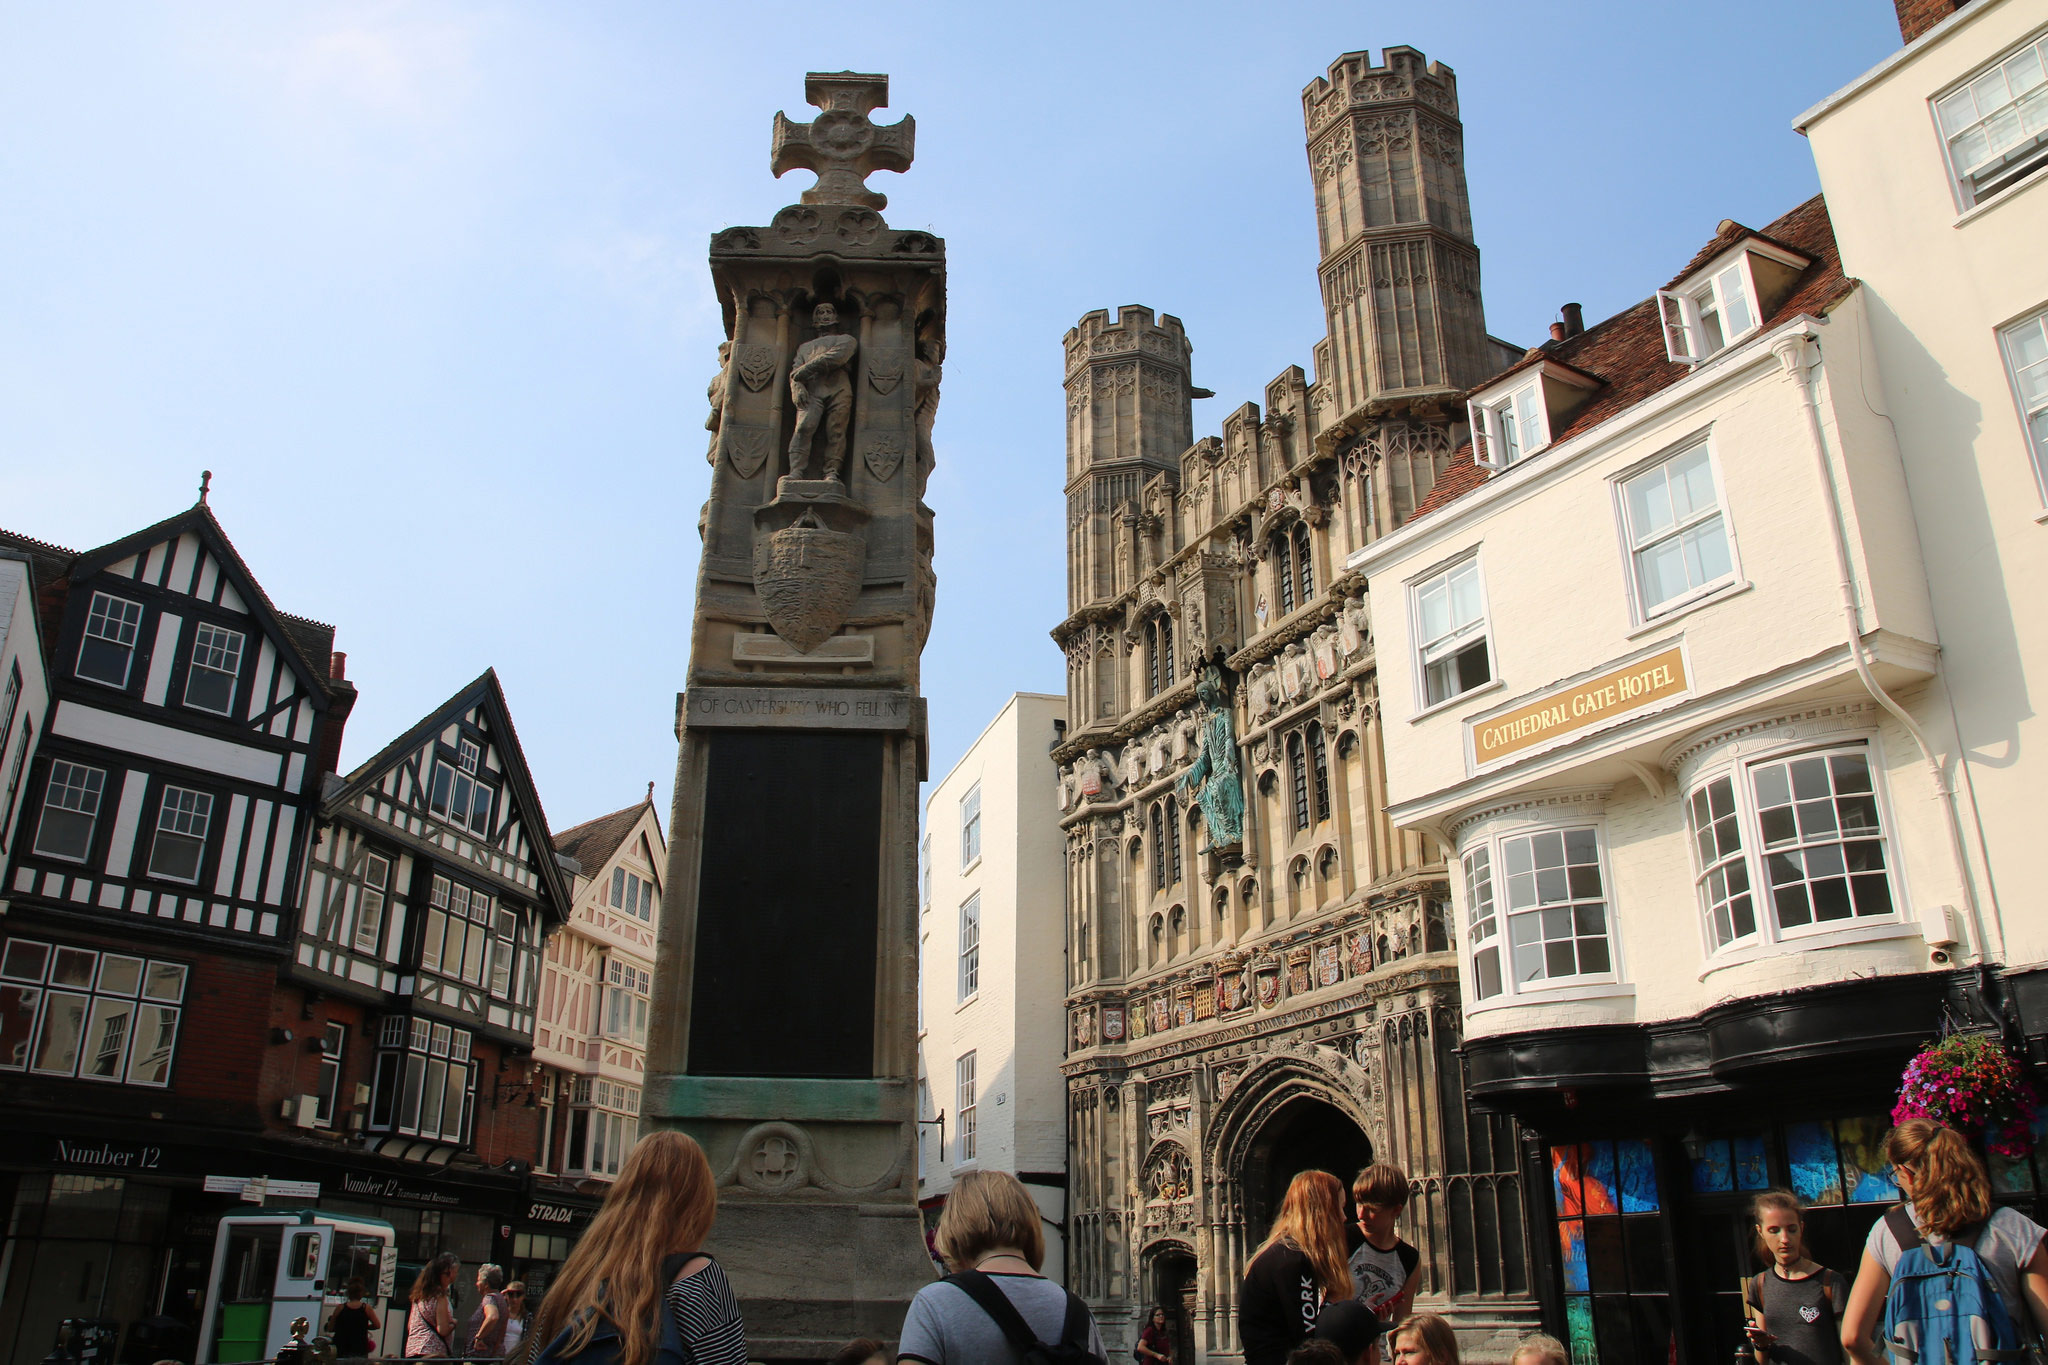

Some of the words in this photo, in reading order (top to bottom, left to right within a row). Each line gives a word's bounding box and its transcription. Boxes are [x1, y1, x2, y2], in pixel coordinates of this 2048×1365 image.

[699, 698, 719, 714] OF
[724, 698, 811, 716] CANTERBURY
[815, 700, 850, 717] WHO
[855, 701, 881, 717] FELL
[884, 701, 899, 717] IN
[1482, 703, 1570, 750] CATHEDRAL
[1572, 685, 1616, 718] GATE
[1617, 664, 1675, 702] HOTEL
[51, 1138, 135, 1167] Number
[138, 1145, 161, 1168] 12
[338, 1172, 383, 1195] Number
[383, 1178, 398, 1197] 12
[528, 1203, 573, 1224] STRADA
[1300, 1274, 1316, 1333] YORK
